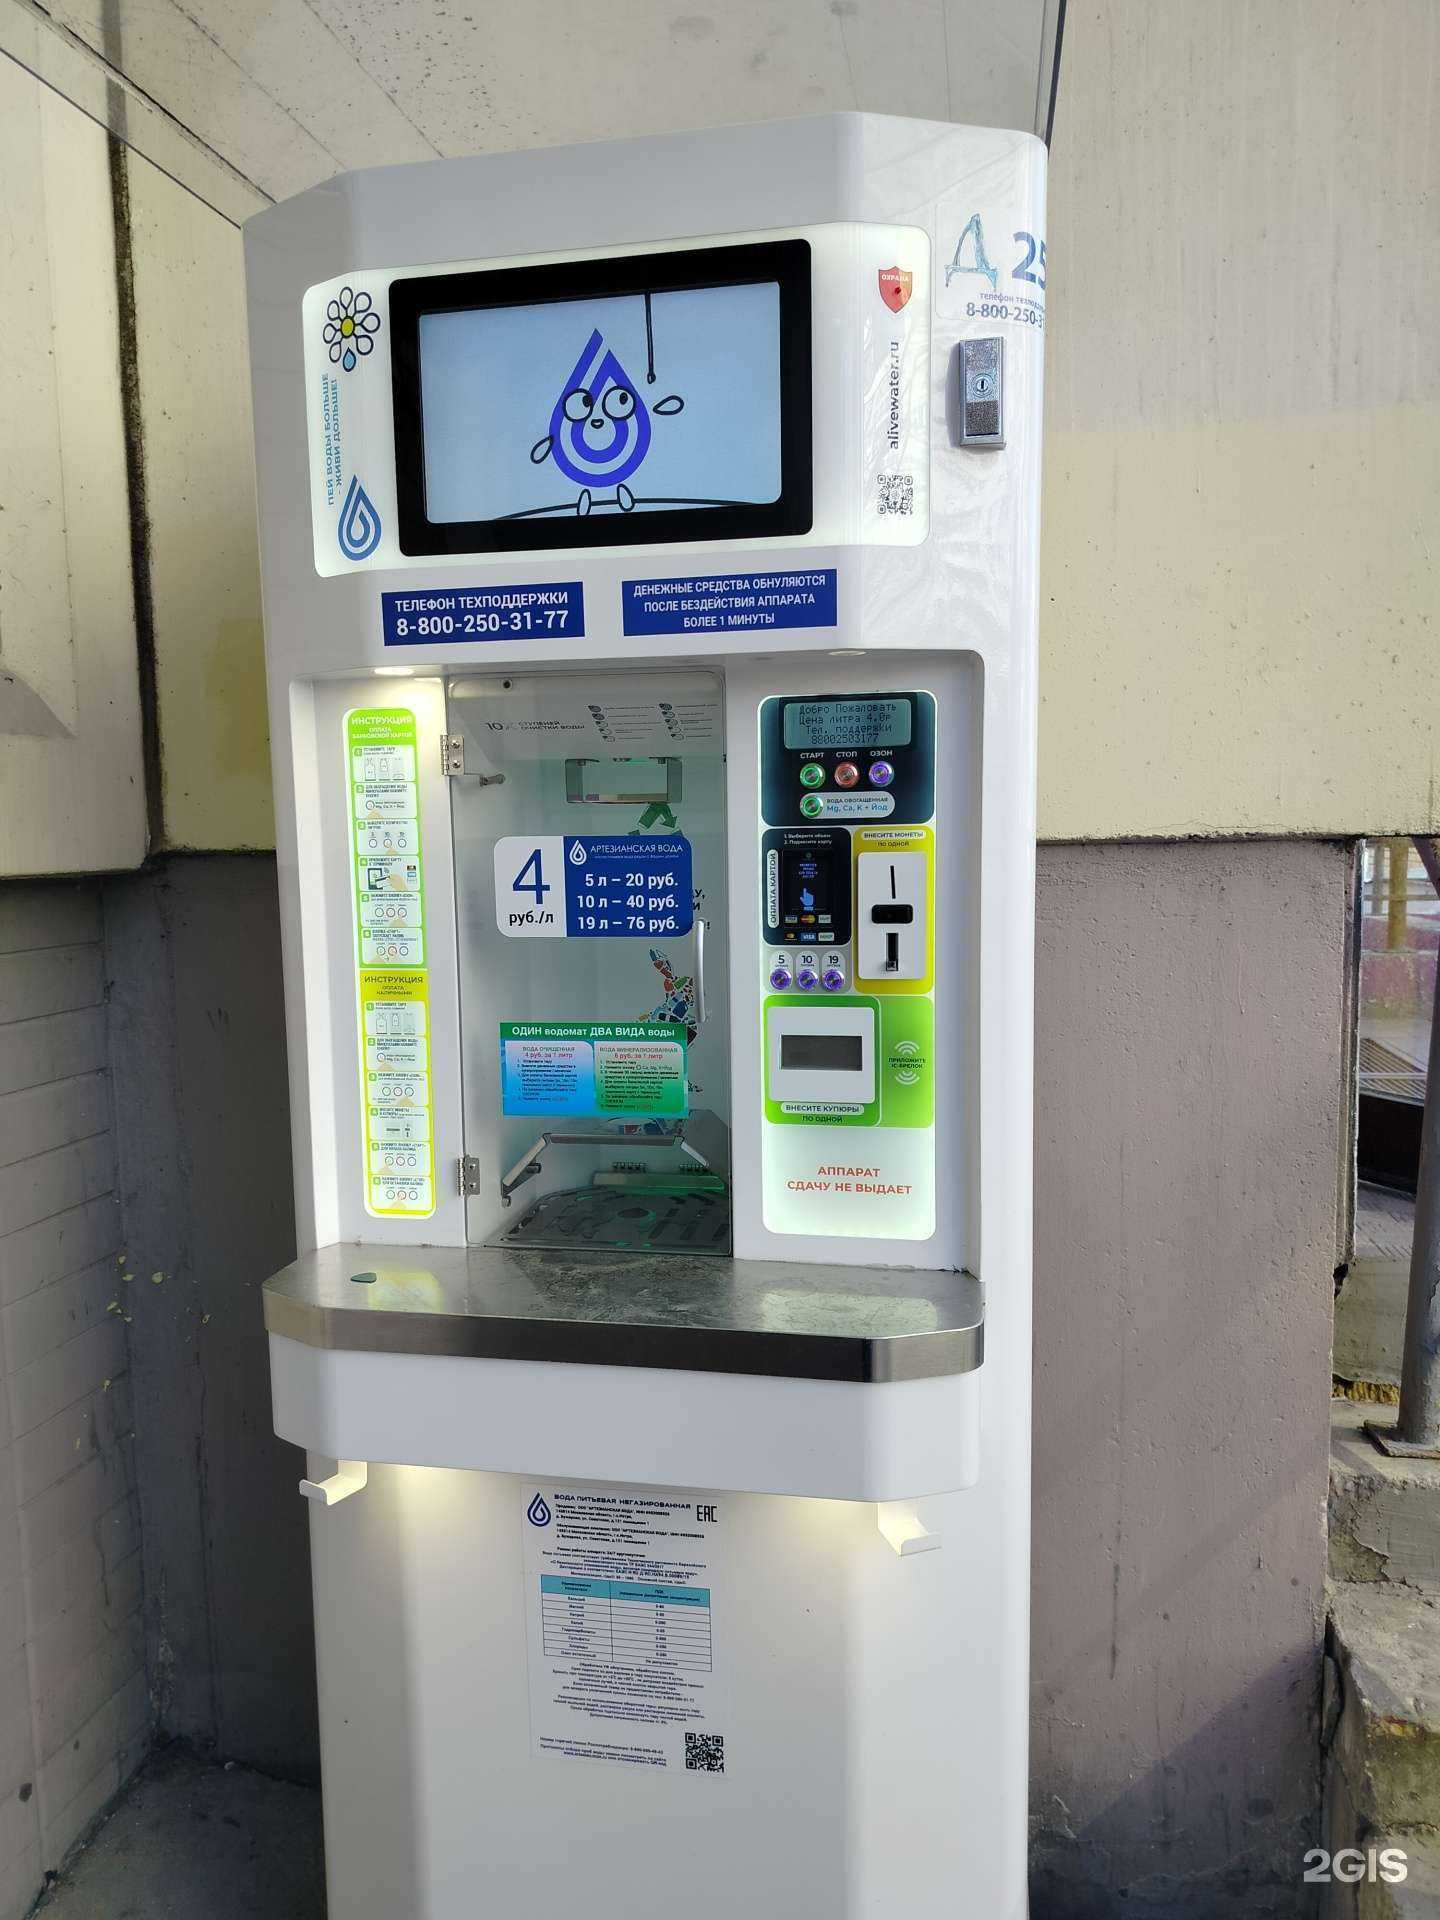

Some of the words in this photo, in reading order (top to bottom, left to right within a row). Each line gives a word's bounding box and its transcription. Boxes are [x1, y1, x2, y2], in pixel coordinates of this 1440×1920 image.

[980, 293, 1014, 303] телефон
[322, 373, 330, 431] БОЛЬШЕ
[888, 341, 899, 450] alivewater.ru
[331, 379, 341, 442] ДОЛЬШЕ!
[325, 435, 333, 475] ВОДЫ
[333, 446, 342, 487] ЖИВИ
[634, 584, 693, 597] ДЕНЕЖНЫЕ
[695, 579, 750, 594] СРЕДСТВА
[752, 574, 826, 589] ОБНУЛЯЮТСЯ
[395, 597, 456, 612] ТЕЛЕФОН
[458, 591, 568, 610] ТЕХПОДДЕРЖКИ
[644, 600, 678, 612] ПОСЛЕ
[681, 596, 755, 612] БЕЗДЕЙСТВИЯ
[757, 593, 815, 606] АППАРАТА
[396, 610, 569, 636] 8-800-250-31-77
[684, 616, 717, 628] БОЛЕЕ
[719, 616, 725, 626] 1
[727, 613, 775, 626] МИНУТЫ
[800, 704, 829, 715] Добро
[835, 703, 896, 714] Пожаловать
[351, 716, 412, 725] ИНСТРУКЦИЯ
[800, 715, 823, 725] Цена
[829, 715, 860, 724] литра
[806, 725, 828, 735] Тел.
[835, 724, 892, 735] поддержки
[811, 733, 879, 745] 88002503177
[827, 805, 841, 813] Mg,
[871, 803, 888, 812] Йод
[591, 844, 656, 853] АРТЕЗИАНСКАЯ
[658, 844, 683, 853] ВОДА
[512, 848, 551, 905] 4
[585, 873, 594, 886] 5
[597, 876, 607, 886] л
[625, 873, 644, 886] 20
[648, 872, 679, 889] руб.
[577, 895, 595, 908] 10
[599, 898, 608, 908] л
[626, 895, 645, 908] 40
[649, 894, 679, 911] руб.
[769, 888, 777, 923] ОПЛАТА
[509, 910, 554, 926] руб./л
[577, 916, 595, 929] 19
[599, 919, 608, 929] л
[626, 916, 645, 929] 76
[649, 915, 679, 932] руб.
[778, 954, 785, 964] 5
[801, 955, 813, 964] 10
[828, 955, 839, 964] 19
[364, 976, 423, 984] ИНСТРУКЦИЯ
[512, 1026, 542, 1037] ОДИН
[545, 1028, 587, 1037] водомат
[590, 1026, 612, 1037] ДВА
[617, 1027, 645, 1037] ВИДА
[648, 1028, 675, 1037] воды
[785, 1104, 821, 1112] ВНЕСИТЕ
[823, 1104, 859, 1113] КУПЮРЫ
[815, 1114, 843, 1124] ОДНОЙ
[817, 1166, 880, 1178] АППАРАТ
[787, 1180, 831, 1191] СДАЧУ
[835, 1182, 852, 1192] НЕ
[855, 1183, 912, 1195] ВЫДАЕТ
[576, 1496, 617, 1504] ПИТЬЕВАЯ
[620, 1499, 691, 1509] НЕГАЗИРОВАННАЯ
